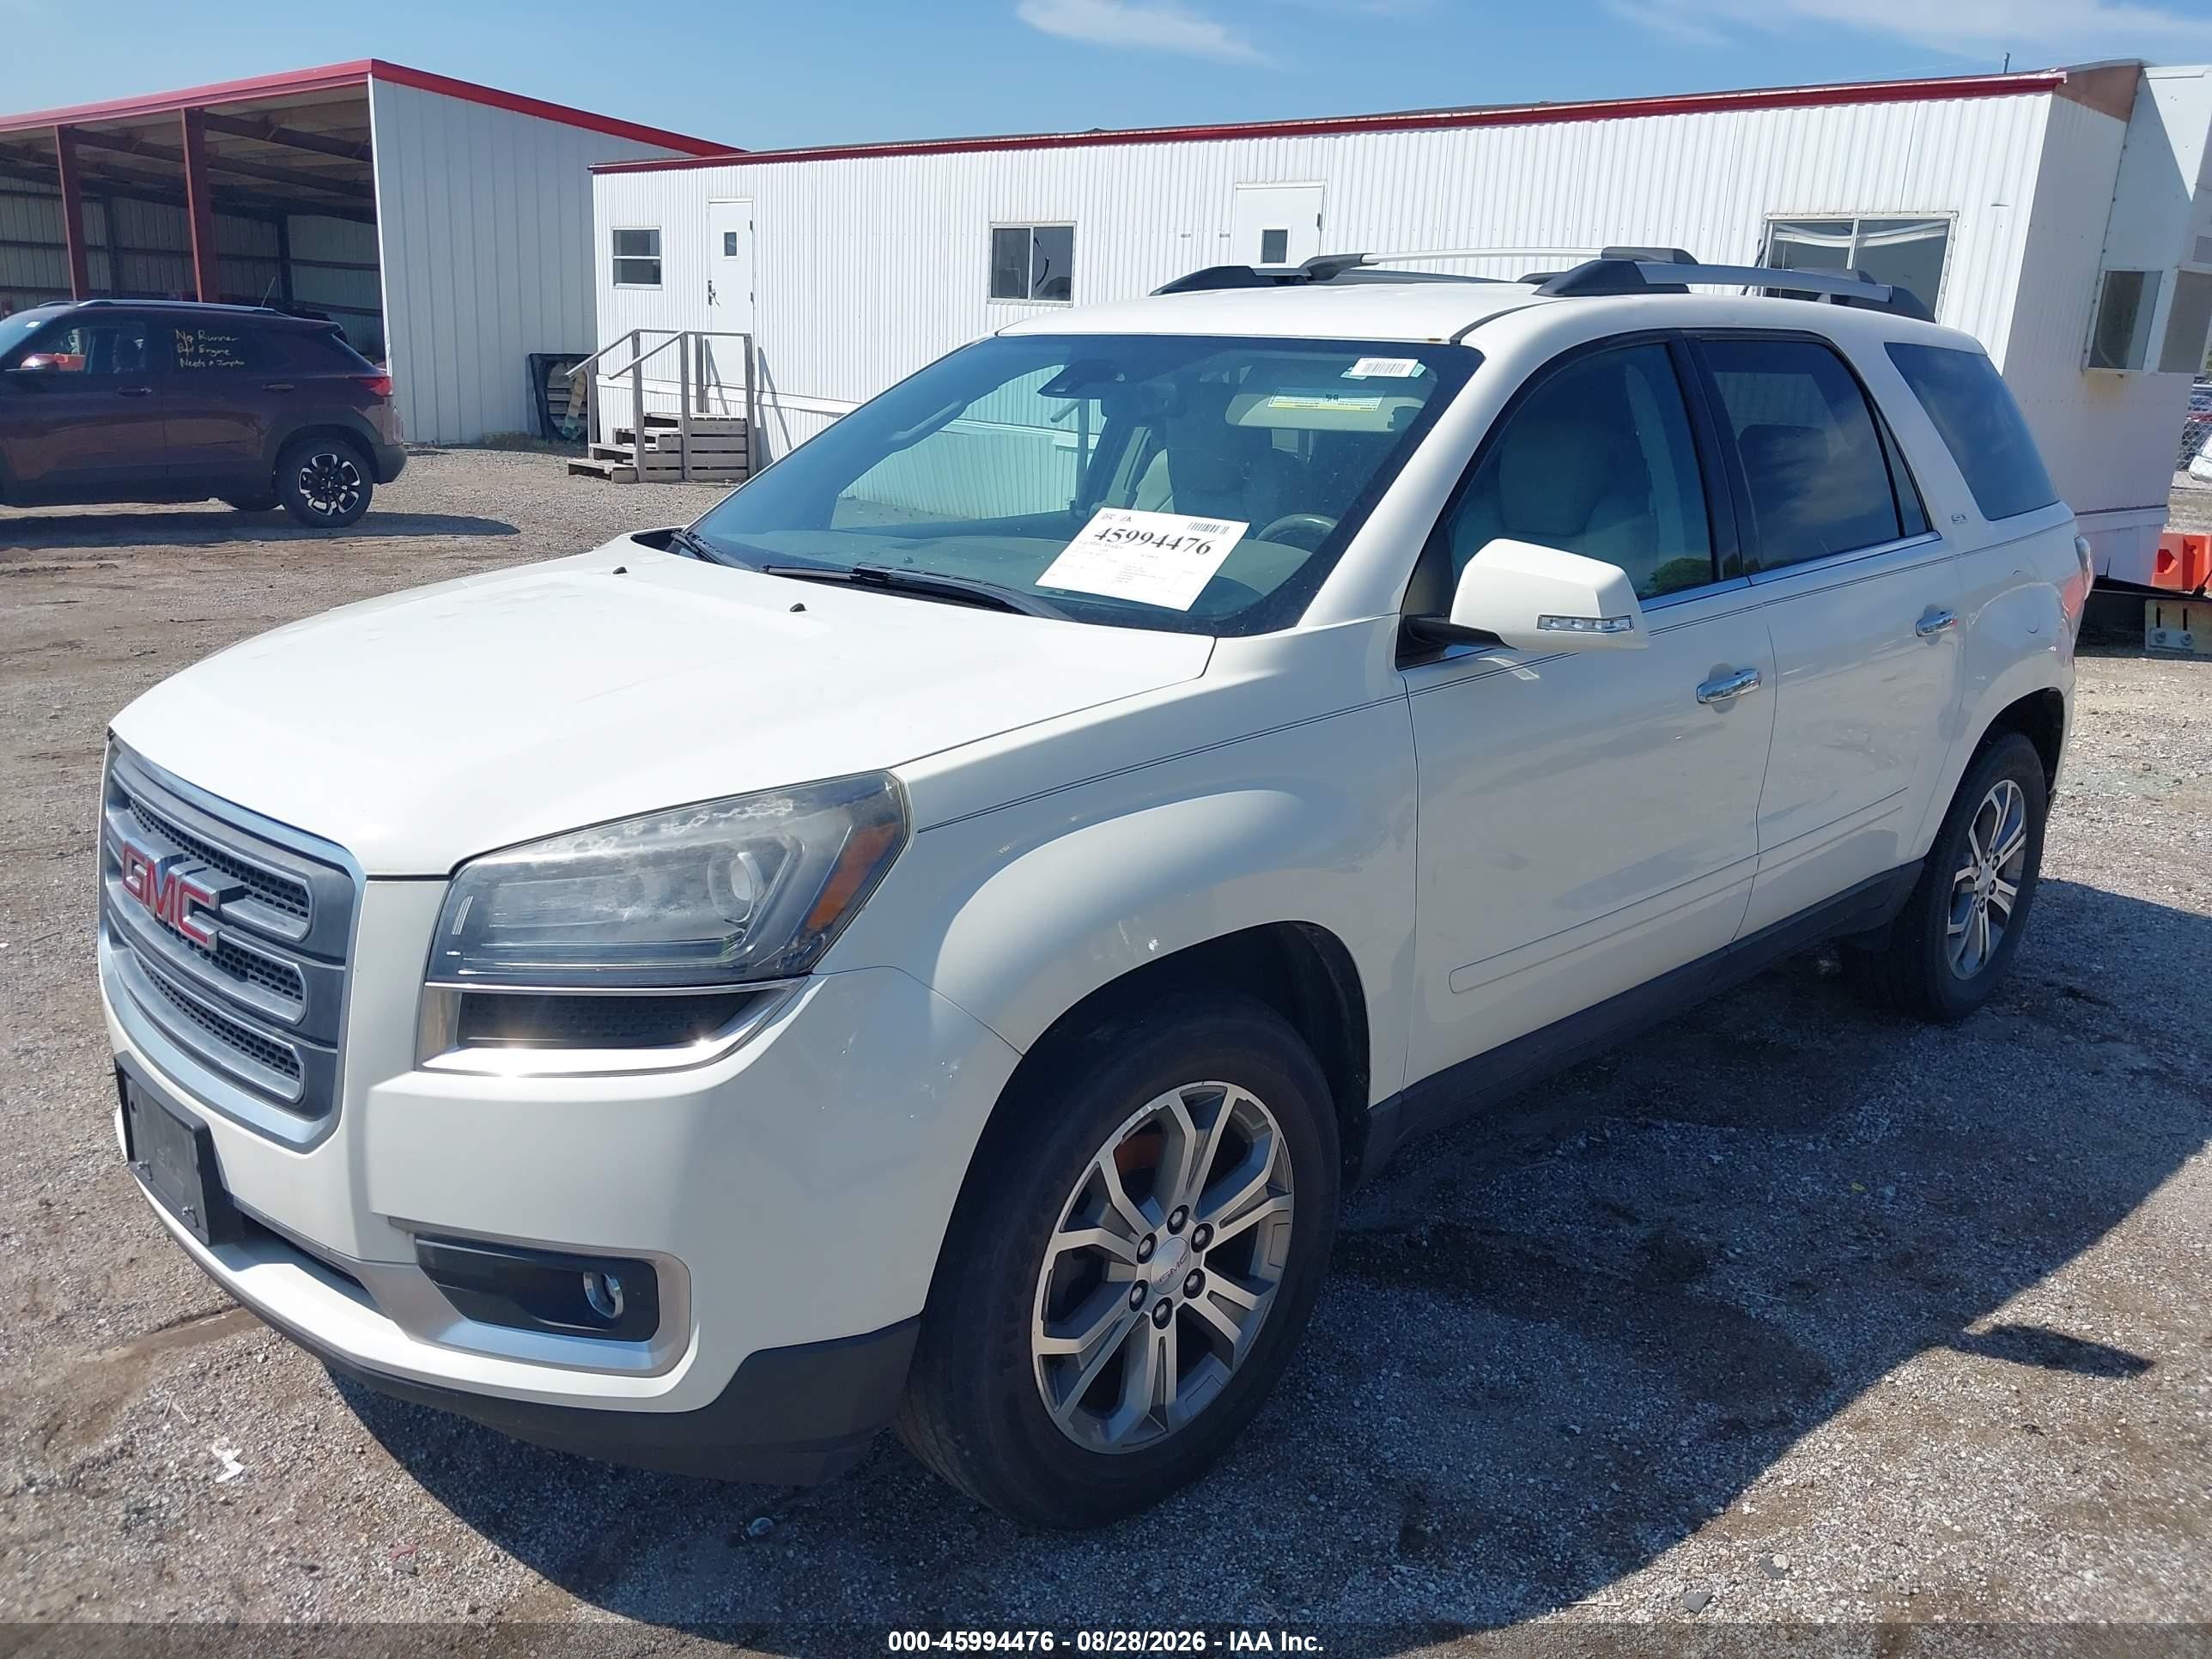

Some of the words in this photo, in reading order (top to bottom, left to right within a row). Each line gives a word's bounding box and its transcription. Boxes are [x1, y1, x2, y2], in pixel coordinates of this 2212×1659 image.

[174, 329, 194, 344] No
[198, 330, 240, 342] Runner
[177, 343, 194, 354] Bad
[198, 344, 231, 357] Engine
[179, 358, 206, 368] Needs
[1094, 527, 1216, 556] 45994476
[123, 841, 218, 951] GMC
[1159, 1250, 1188, 1285] GMC
